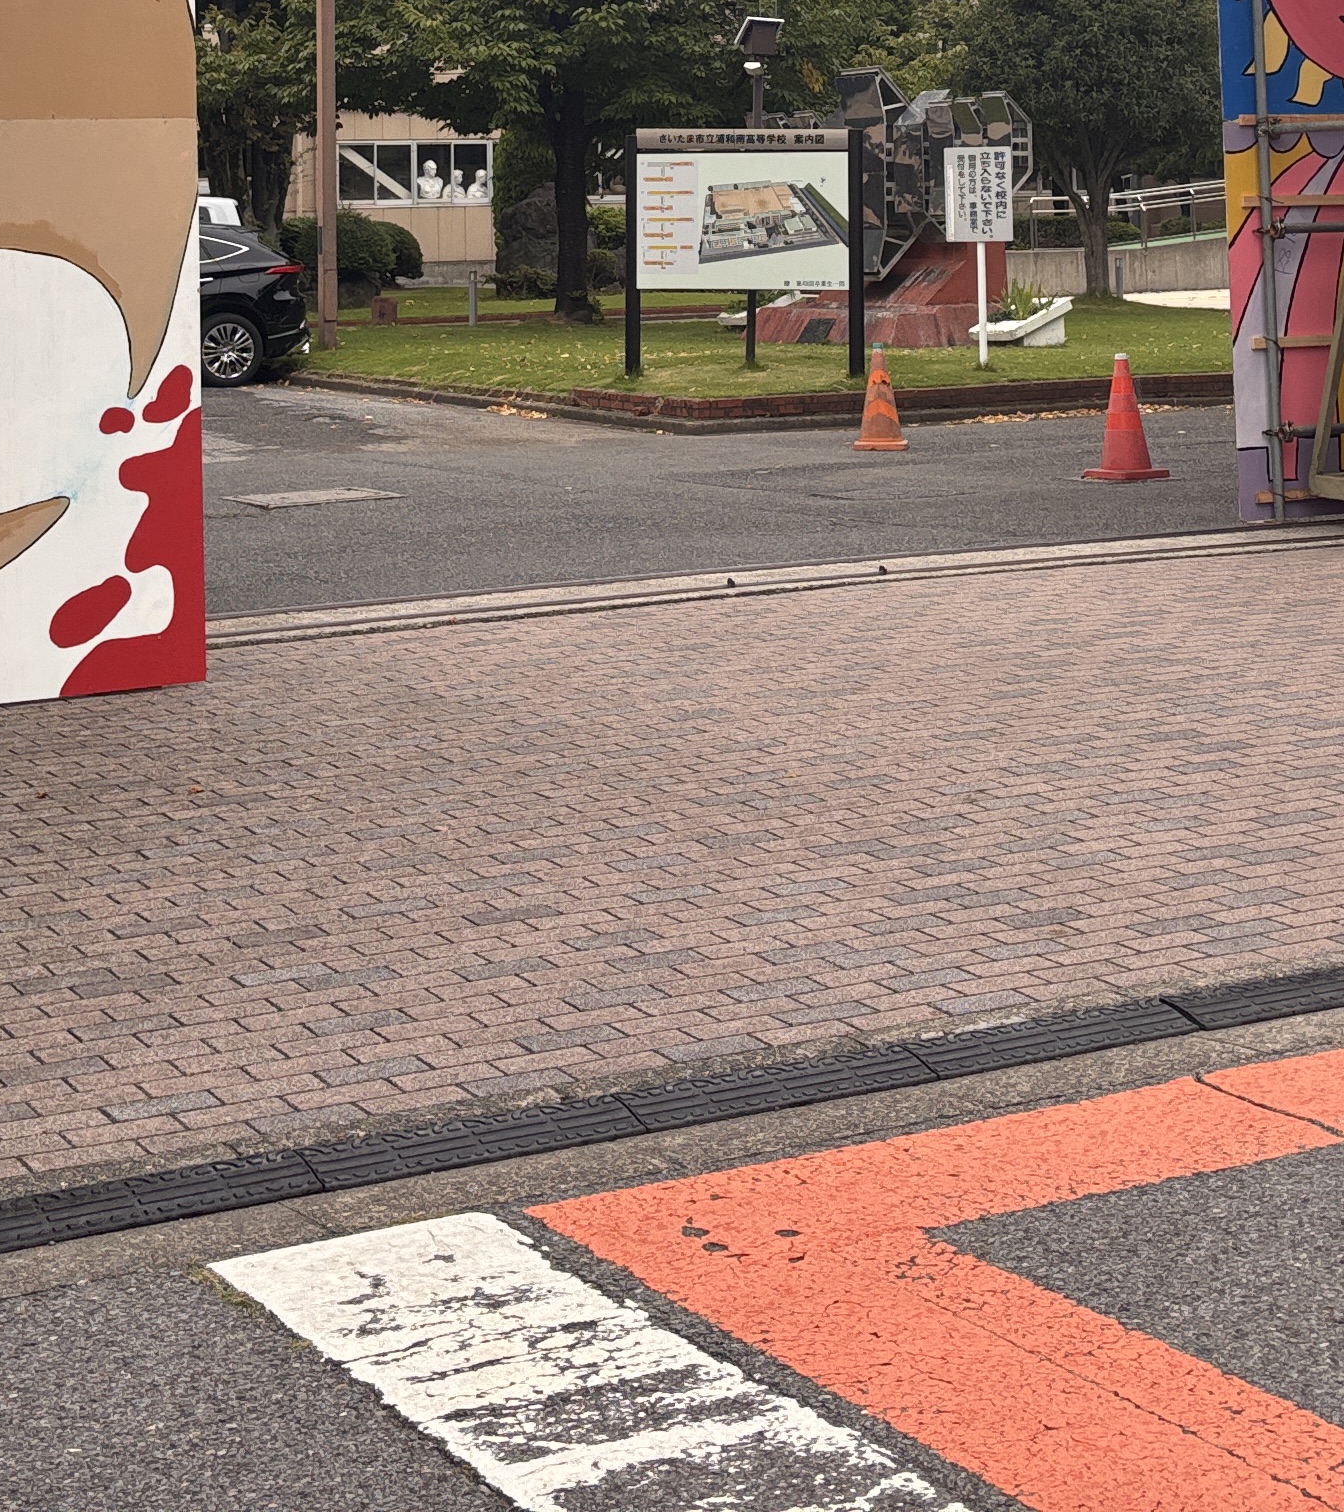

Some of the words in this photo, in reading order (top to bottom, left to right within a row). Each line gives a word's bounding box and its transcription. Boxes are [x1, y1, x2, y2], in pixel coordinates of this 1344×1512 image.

[793, 133, 825, 145] 案内図
[979, 151, 994, 239] 立ち入らないで下さい。
[994, 151, 1008, 219] 許可なく校内に
